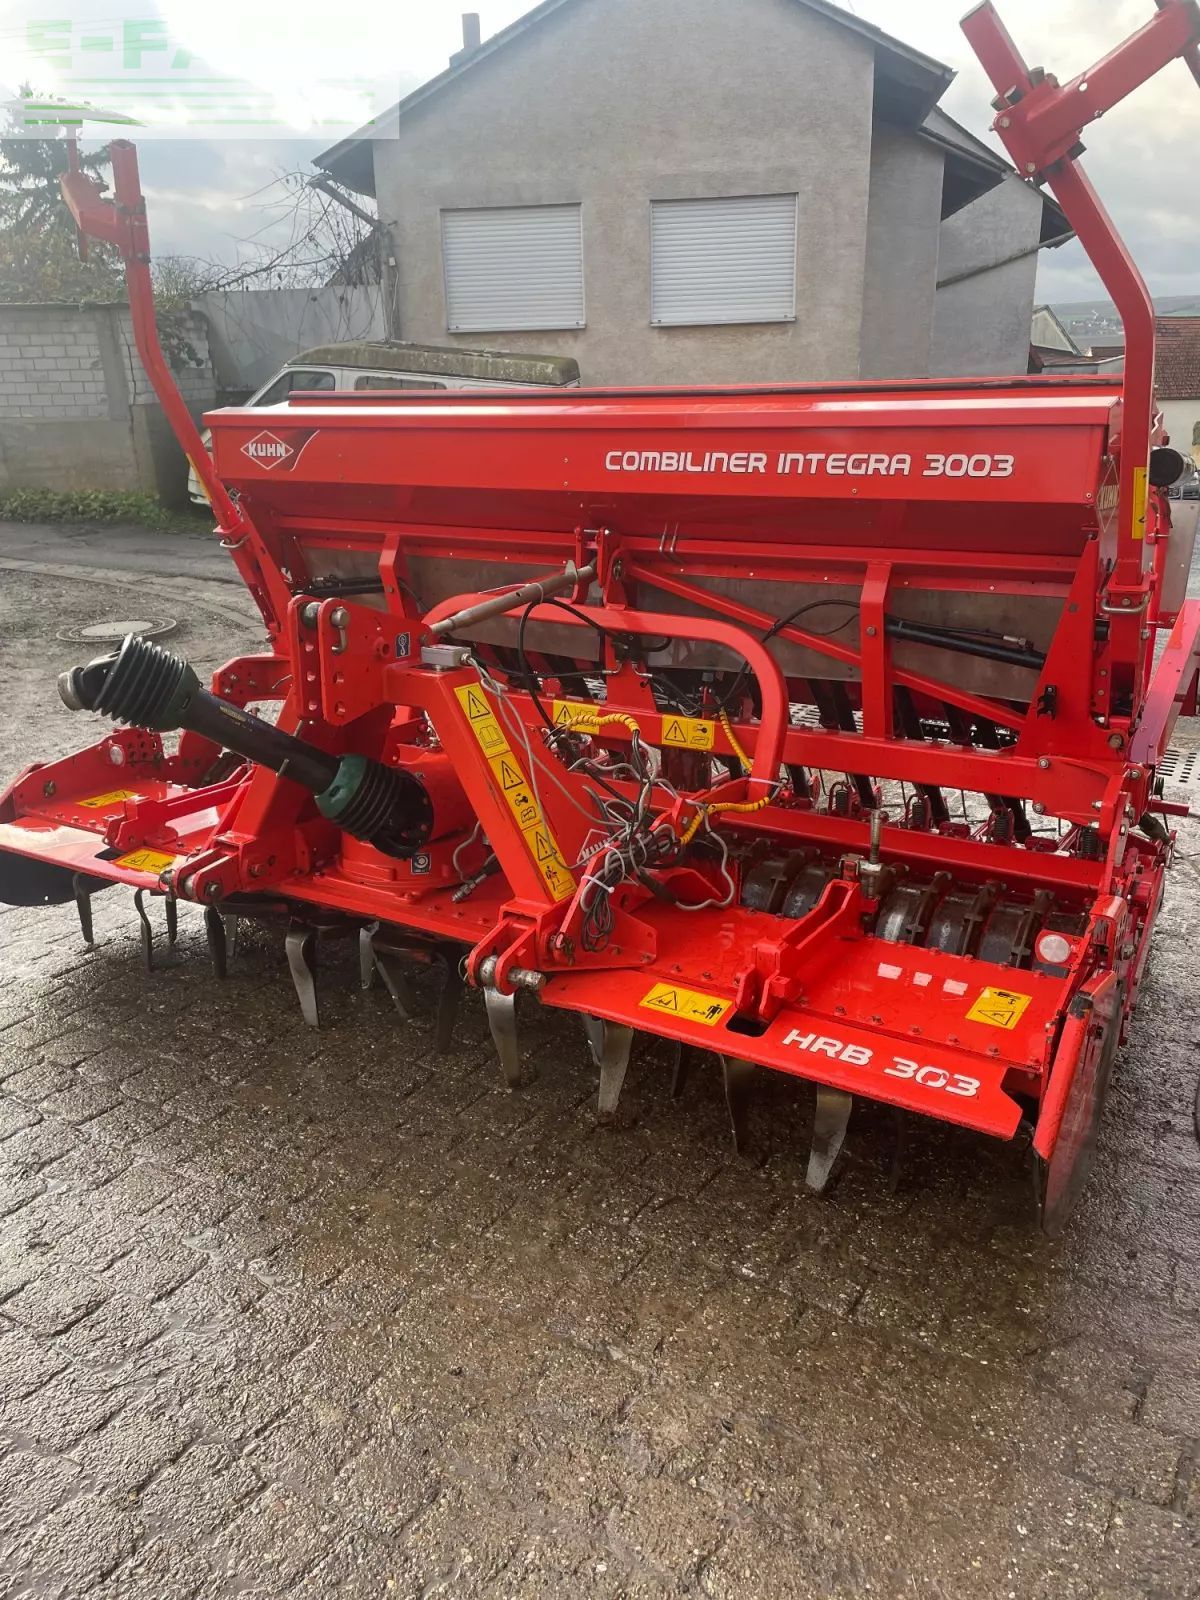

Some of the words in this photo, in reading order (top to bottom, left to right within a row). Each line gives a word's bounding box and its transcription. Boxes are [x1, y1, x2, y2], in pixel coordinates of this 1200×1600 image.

[248, 442, 286, 457] KUHN
[605, 451, 768, 474] COMBILINER
[777, 452, 912, 476] INTEGRA
[922, 453, 1015, 477] 3003
[782, 1029, 874, 1066] HRB
[884, 1056, 981, 1097] 303
